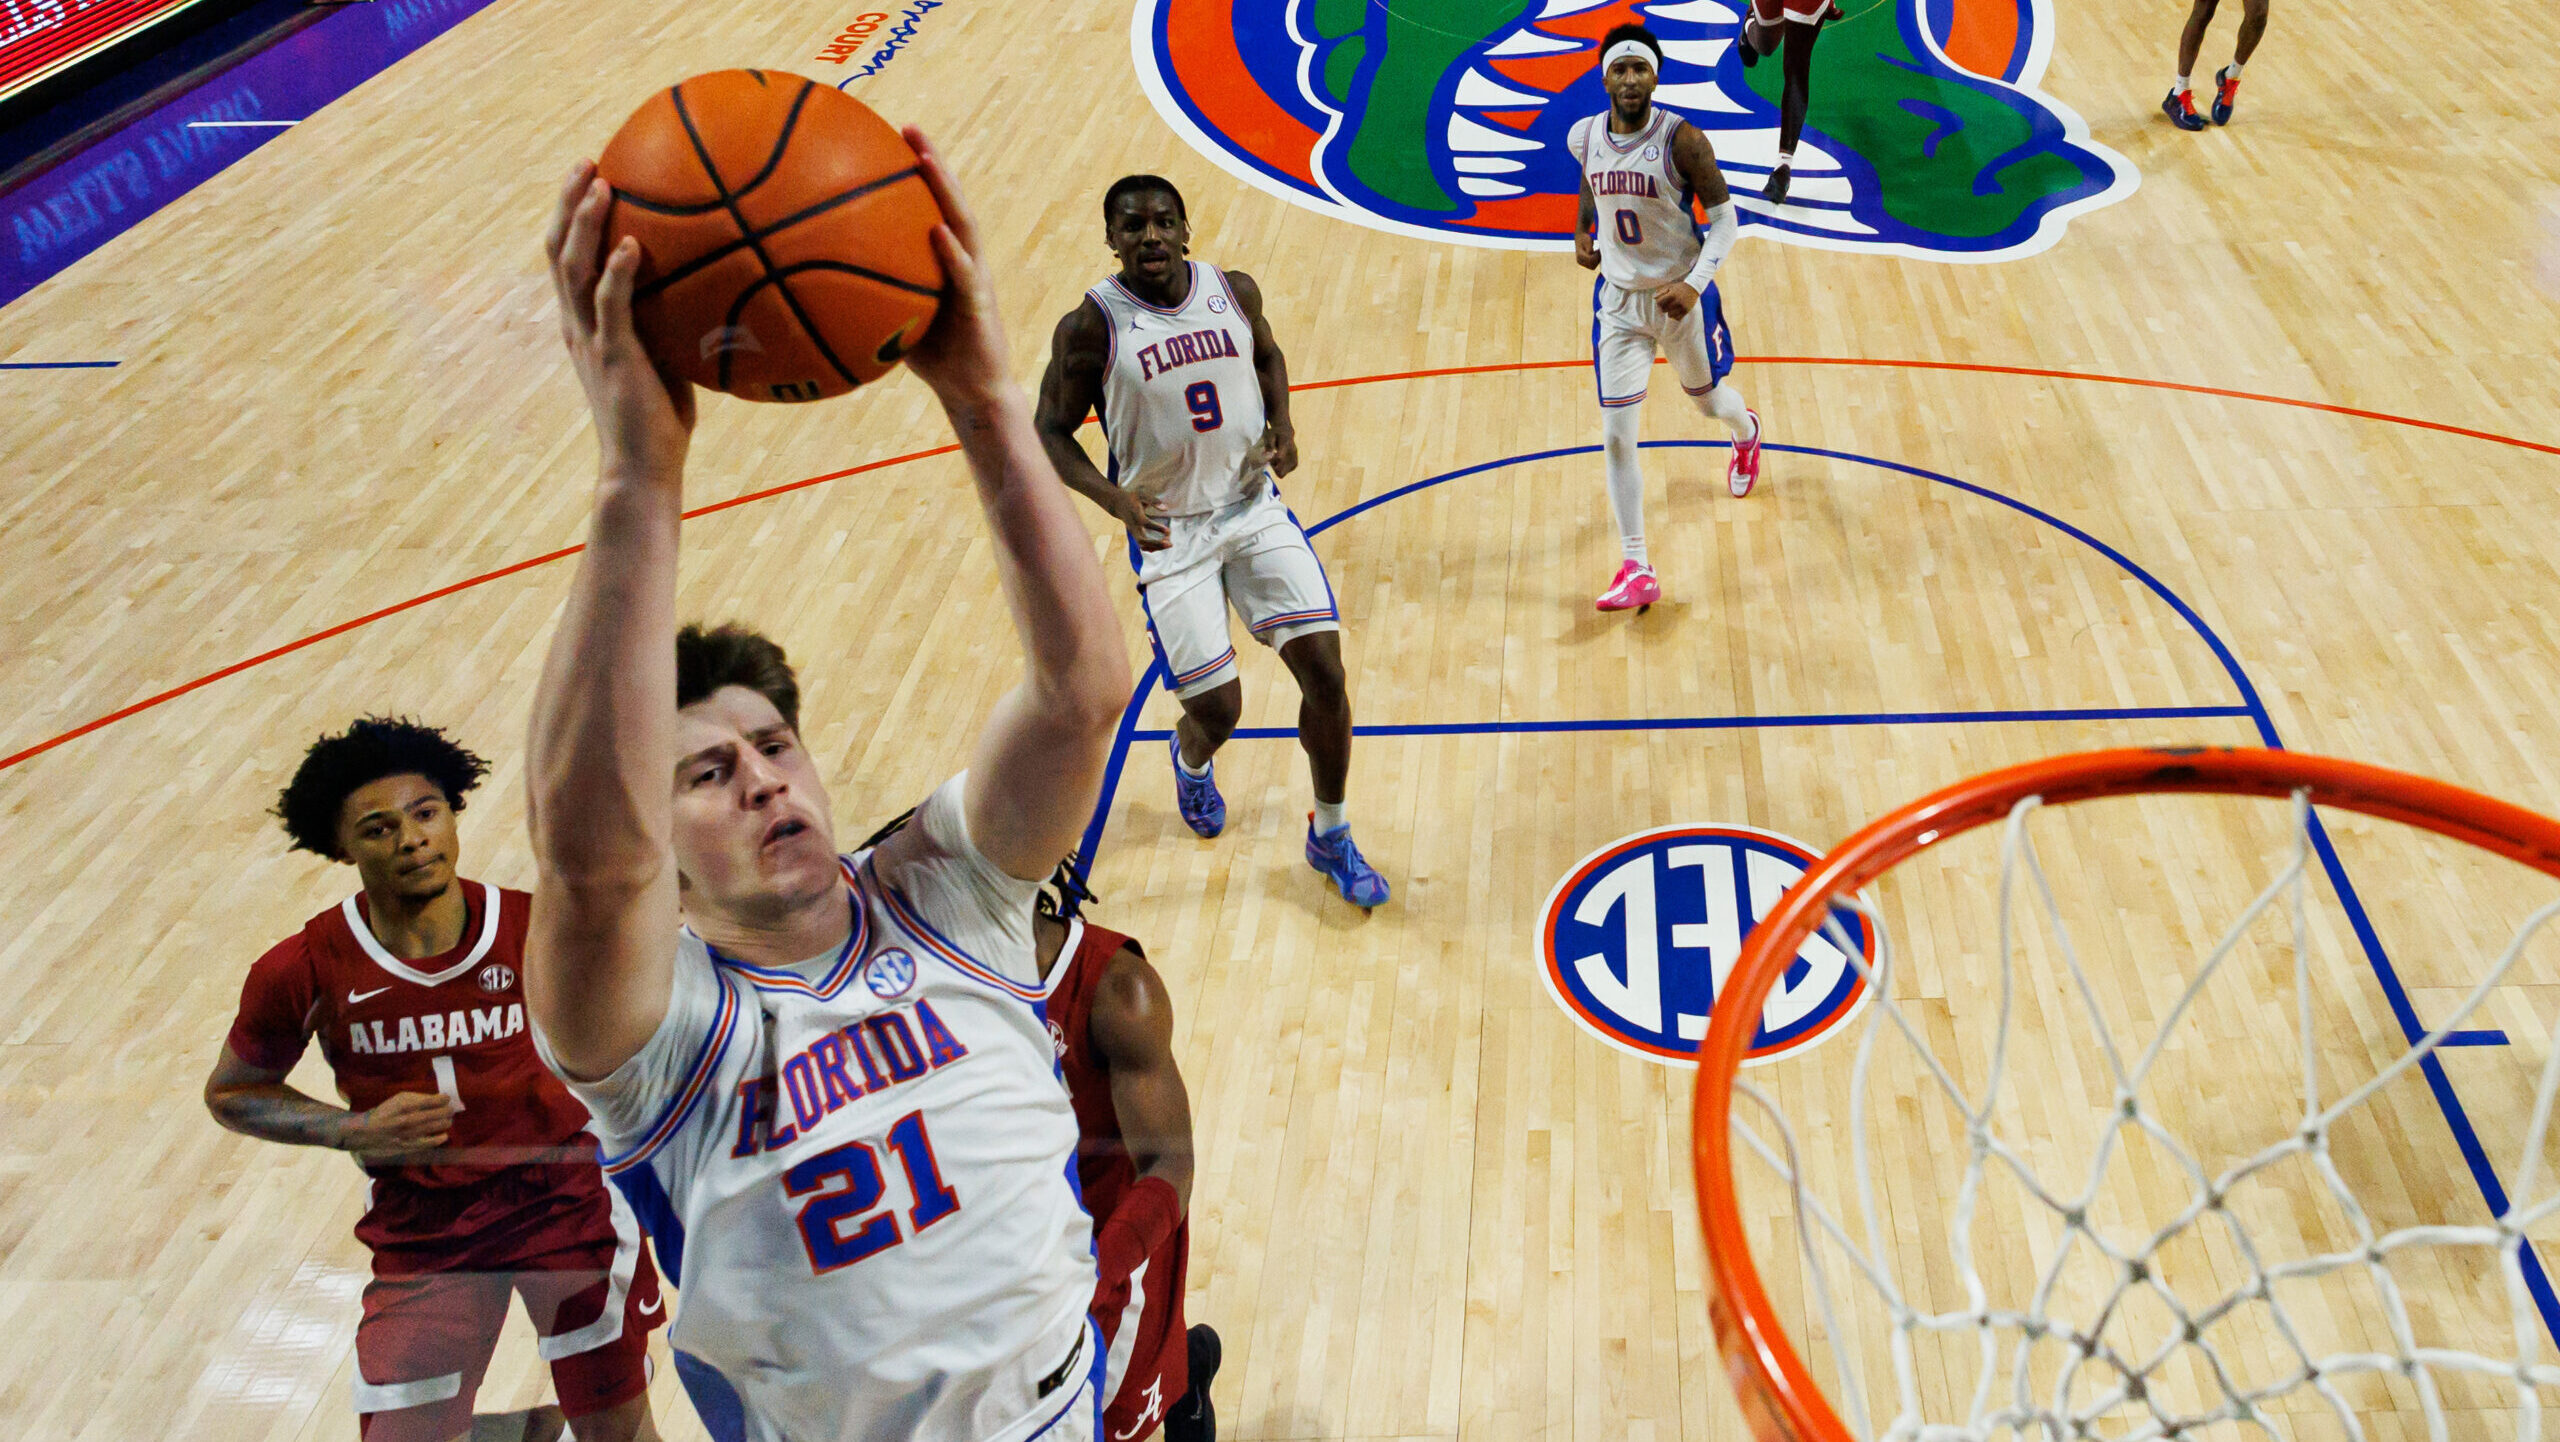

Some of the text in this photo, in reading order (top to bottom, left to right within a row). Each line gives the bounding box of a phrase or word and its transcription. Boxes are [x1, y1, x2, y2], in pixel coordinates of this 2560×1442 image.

[814, 12, 889, 65] COURT
[1590, 169, 1660, 199] FLORIDA
[1615, 208, 1644, 246] 0
[1137, 328, 1240, 382] FLORIDA
[1184, 379, 1224, 433] 9
[1573, 844, 1848, 1041] SEC
[478, 963, 515, 994] SEC
[864, 947, 917, 999] SEC
[349, 1002, 524, 1054] ALABAMA
[431, 1055, 467, 1113] 1
[731, 997, 969, 1160] FLORIDA
[781, 1109, 961, 1277] 21
